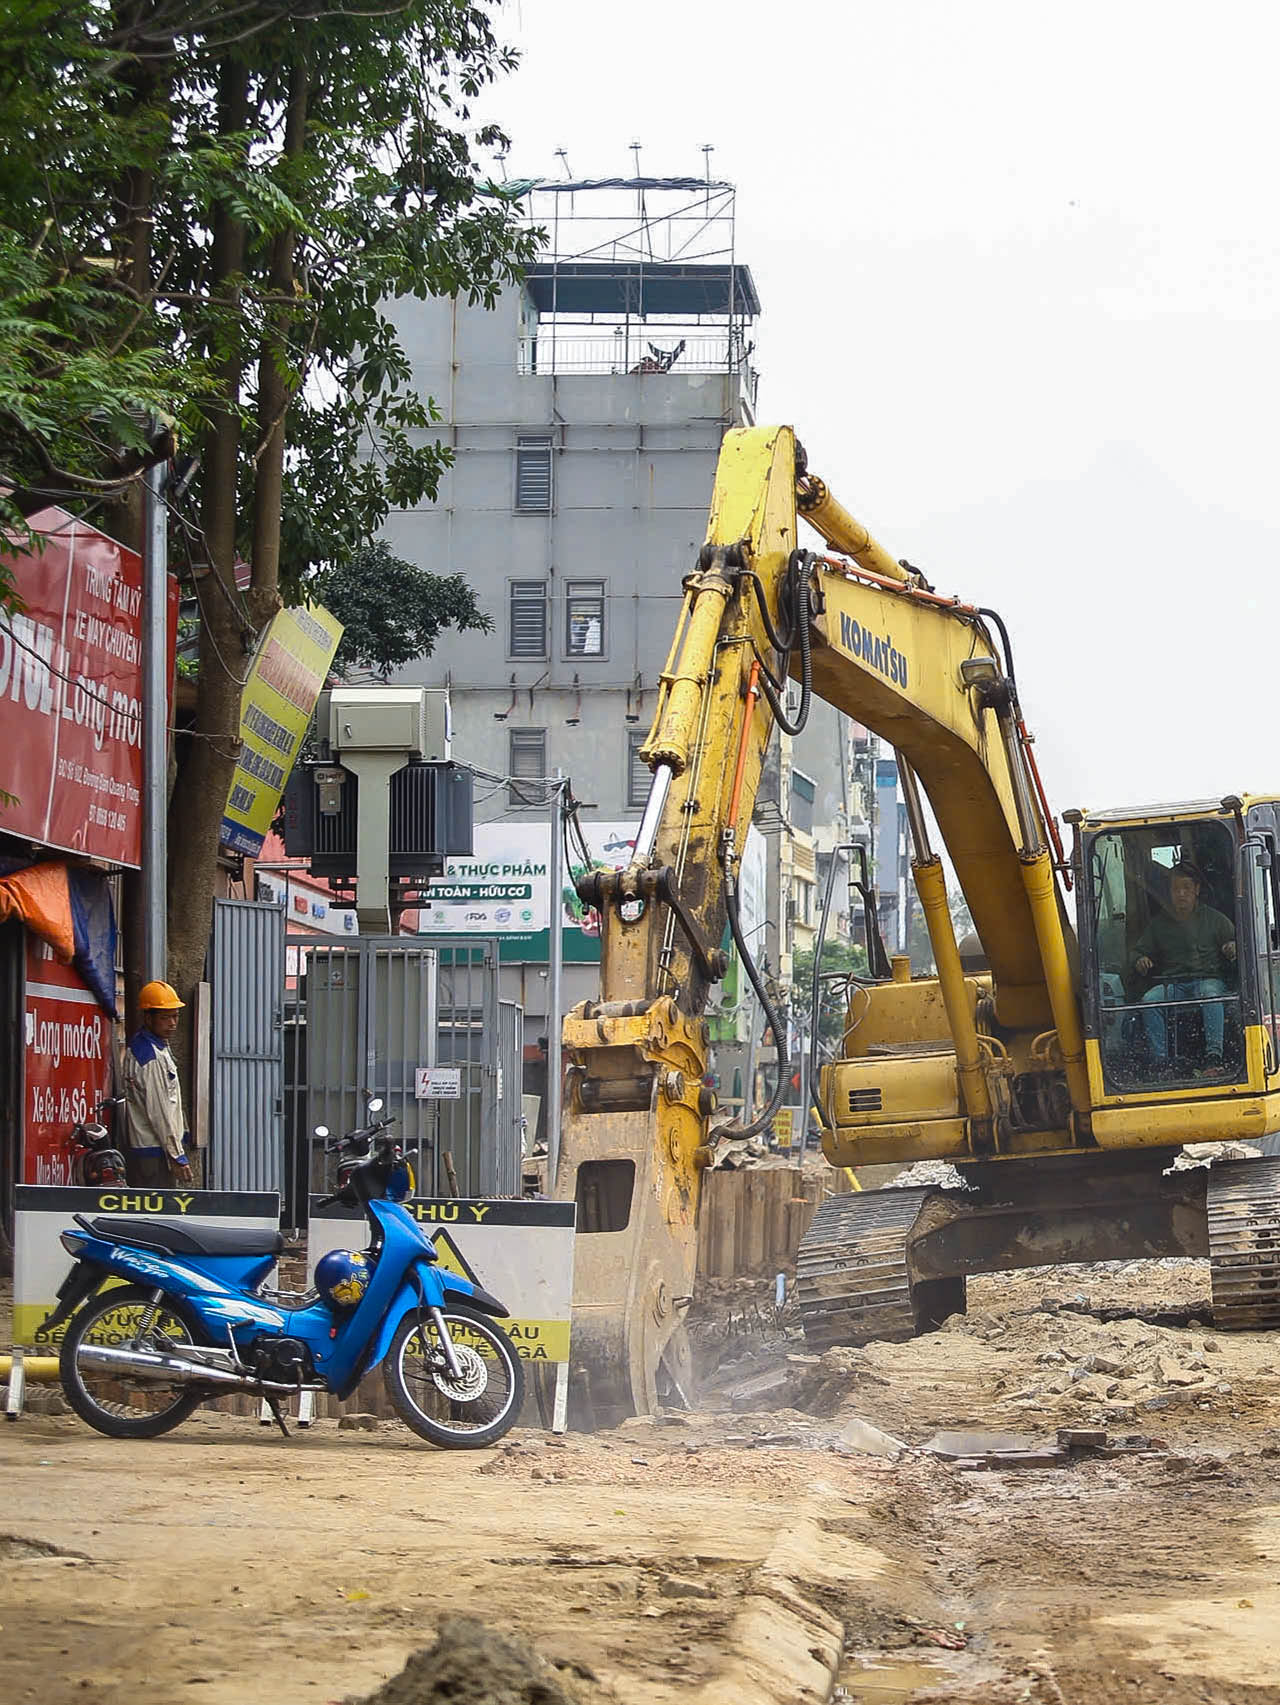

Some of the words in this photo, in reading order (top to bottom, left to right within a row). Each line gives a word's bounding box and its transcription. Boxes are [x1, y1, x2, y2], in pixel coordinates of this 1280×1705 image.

[74, 608, 87, 641] XE
[840, 610, 907, 690] KOMATSU
[61, 650, 108, 751] Long
[447, 866, 456, 875] &
[459, 863, 499, 879] THỰC
[502, 859, 546, 876] PHẨM
[437, 885, 471, 897] TOÀN
[479, 885, 505, 897] HỮU
[507, 886, 526, 897] CƠ
[34, 1008, 60, 1068] Long
[63, 1015, 102, 1060] motoR
[32, 1087, 44, 1123] Xe
[45, 1087, 54, 1123] Ga
[59, 1087, 70, 1123] Xe
[72, 1081, 87, 1124] Số
[99, 1192, 163, 1212] CHÚ
[174, 1193, 194, 1213] Ý
[469, 1202, 490, 1222] Ý
[506, 1322, 539, 1339] ÂU
[517, 1343, 548, 1359] GÃ
